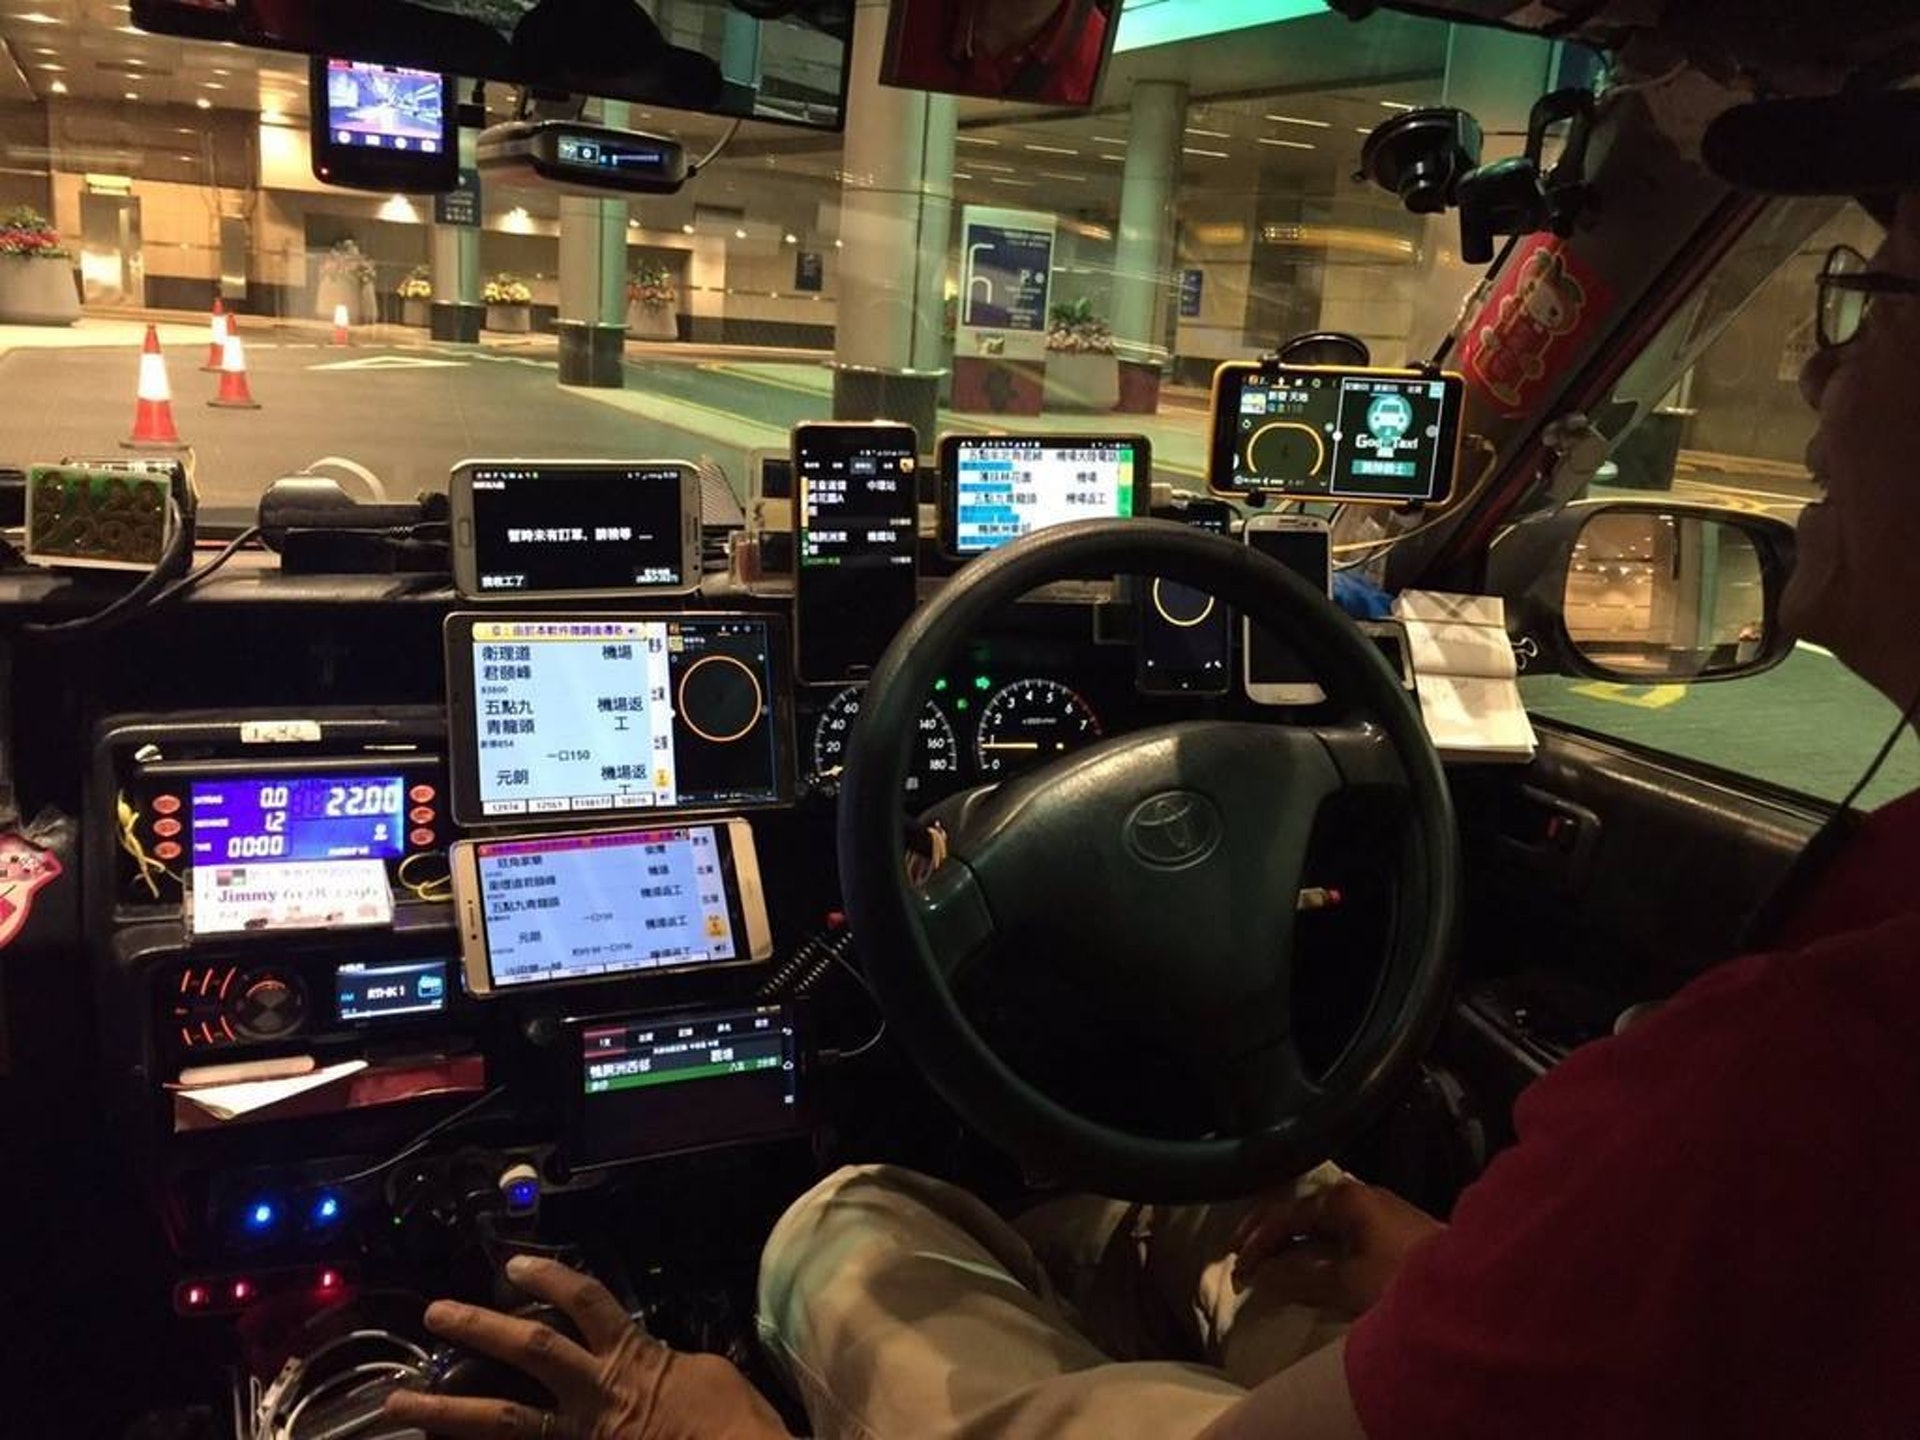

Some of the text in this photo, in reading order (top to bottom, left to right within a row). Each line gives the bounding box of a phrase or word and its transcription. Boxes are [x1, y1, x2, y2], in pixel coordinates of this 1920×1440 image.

[601, 645, 632, 660] 機場
[484, 699, 534, 715] 五點九
[597, 697, 643, 713] 機場返
[843, 702, 859, 714] 60
[615, 717, 630, 731] 工
[830, 719, 846, 731] 40
[919, 718, 937, 730] 140
[826, 741, 841, 753] 20
[927, 738, 945, 750] 160
[929, 758, 947, 770] 180
[496, 770, 529, 786] 元朗
[601, 764, 647, 780] 機場返
[217, 888, 277, 904] Jimmy
